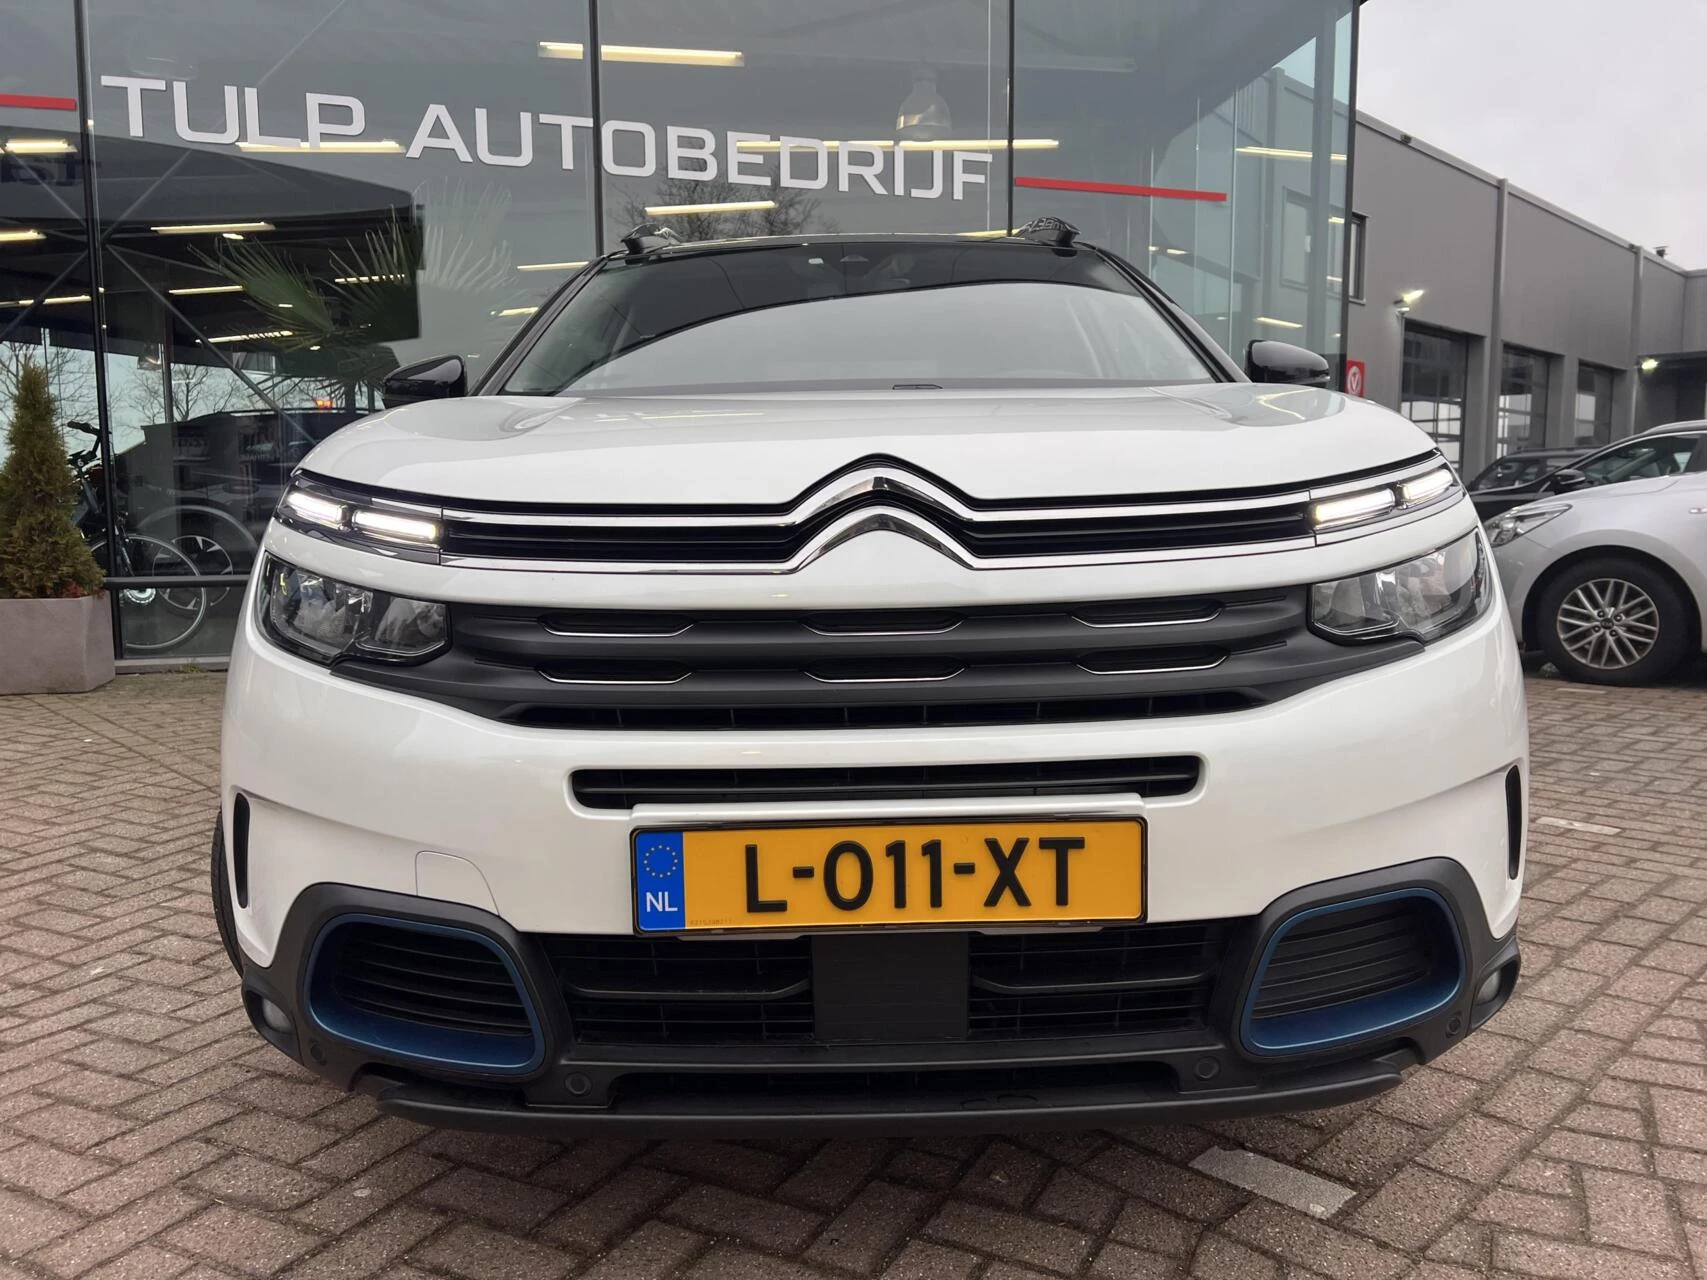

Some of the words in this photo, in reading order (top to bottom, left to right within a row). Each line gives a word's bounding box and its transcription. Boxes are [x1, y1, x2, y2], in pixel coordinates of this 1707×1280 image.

[101, 75, 365, 151] TULP
[405, 103, 993, 201] AUTOBEDRIJF
[646, 891, 678, 912] NL
[744, 836, 1086, 914] L-011-XT
